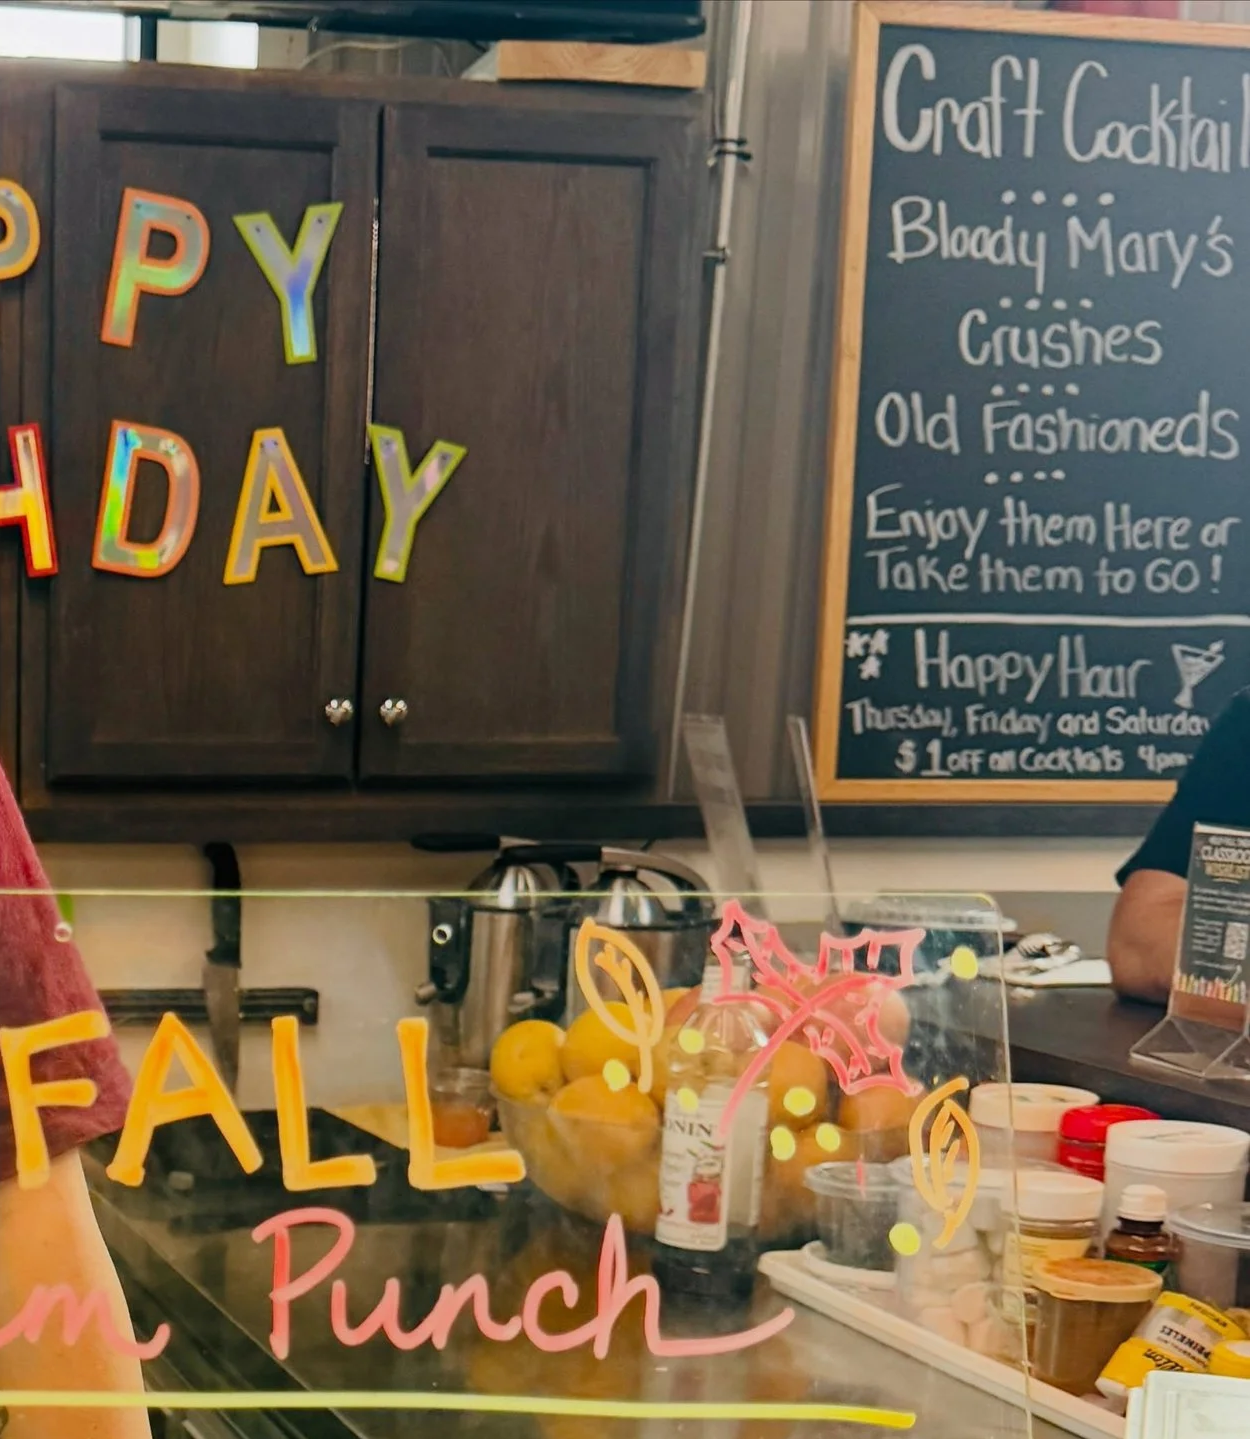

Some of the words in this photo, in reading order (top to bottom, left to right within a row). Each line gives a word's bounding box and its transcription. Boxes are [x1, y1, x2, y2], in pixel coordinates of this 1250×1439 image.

[882, 44, 1044, 159] Craft
[887, 195, 1046, 294] Bloody
[1067, 215, 1234, 290] Mary's
[958, 308, 1163, 369] Crushes
[874, 391, 961, 455] Old
[982, 388, 1241, 460] Fashioneds
[866, 482, 989, 560] Enjoy
[999, 495, 1096, 546] them
[1104, 502, 1192, 552] Here
[1200, 517, 1242, 548] or
[865, 545, 970, 593] Take
[980, 553, 1083, 594] them
[1094, 558, 1134, 595] to
[914, 628, 1053, 703] Happy
[1058, 635, 1152, 699] Hour
[845, 699, 958, 737] Thursday,
[966, 704, 1053, 745] Friday
[1057, 711, 1100, 737] and
[1105, 706, 1210, 736] Saturda
[252, 1207, 795, 1361] Punch
